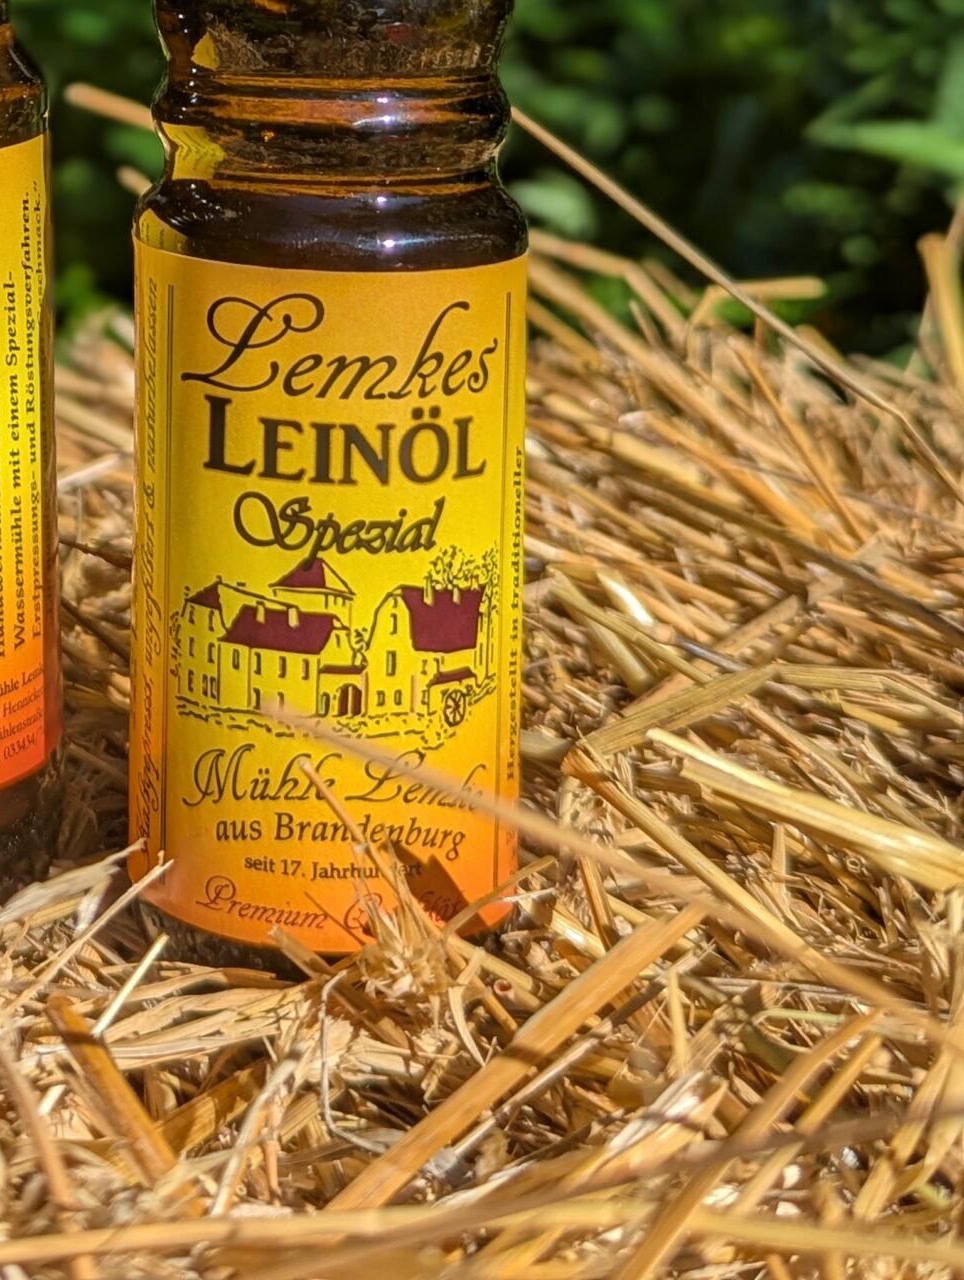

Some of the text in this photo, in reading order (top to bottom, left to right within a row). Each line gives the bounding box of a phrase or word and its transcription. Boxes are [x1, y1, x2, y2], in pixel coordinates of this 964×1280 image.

[21, 192, 36, 413] Röstungsverfahren.
[181, 293, 498, 400] Lemkes
[3, 272, 25, 650] Wassermühle mit einem Spezial-
[25, 422, 37, 464] und
[203, 394, 487, 486] LEINÖL
[142, 482, 156, 510] &
[233, 491, 446, 560] Spezial
[506, 446, 522, 781] Hergestellt in traditioneller
[216, 818, 262, 842] aus
[274, 812, 466, 861] Brandenburg
[244, 855, 276, 873] seit
[281, 858, 306, 878] 17.
[196, 875, 328, 929] Premium
